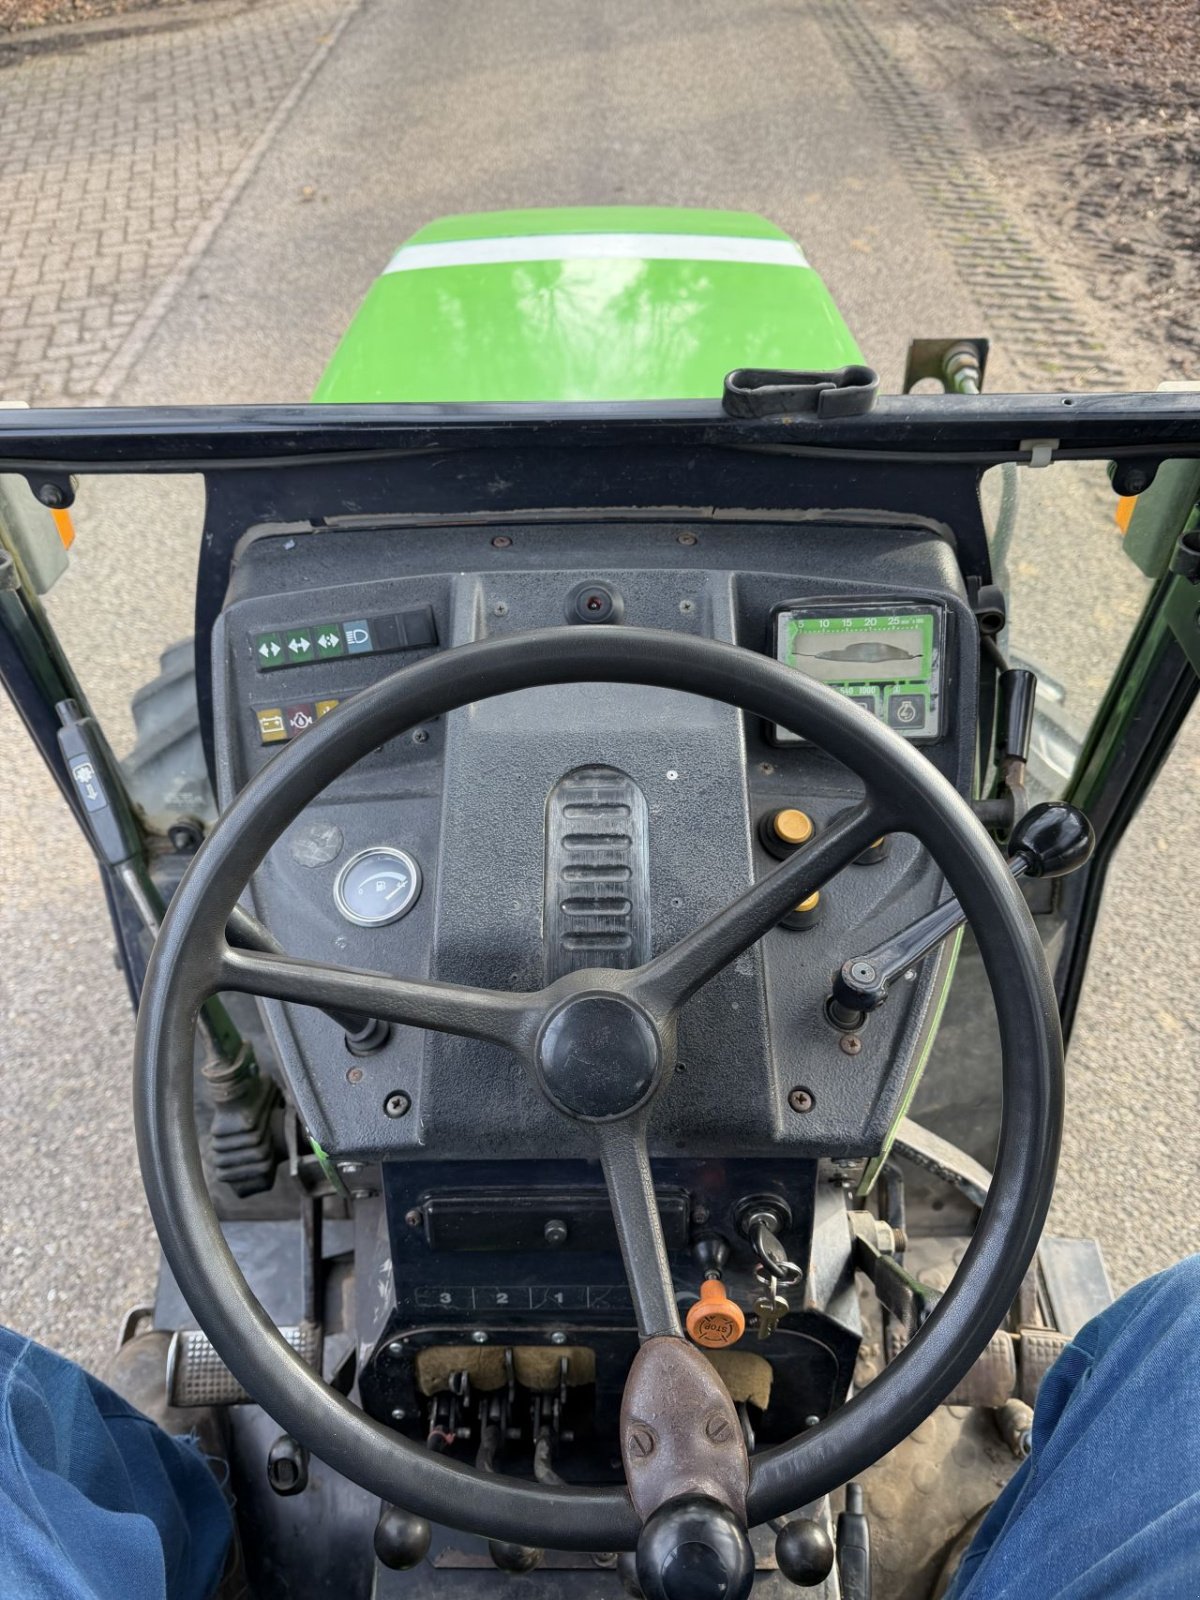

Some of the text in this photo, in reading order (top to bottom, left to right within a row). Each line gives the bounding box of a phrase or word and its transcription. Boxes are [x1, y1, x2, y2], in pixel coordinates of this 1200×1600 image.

[798, 620, 805, 628] 5
[820, 619, 830, 628] 10
[842, 618, 853, 627] 15
[864, 618, 877, 626] 20
[888, 616, 900, 625] 25
[440, 1292, 452, 1304] 3
[496, 1292, 509, 1304] 2
[554, 1292, 564, 1303] 1
[704, 1323, 727, 1332] STOP
